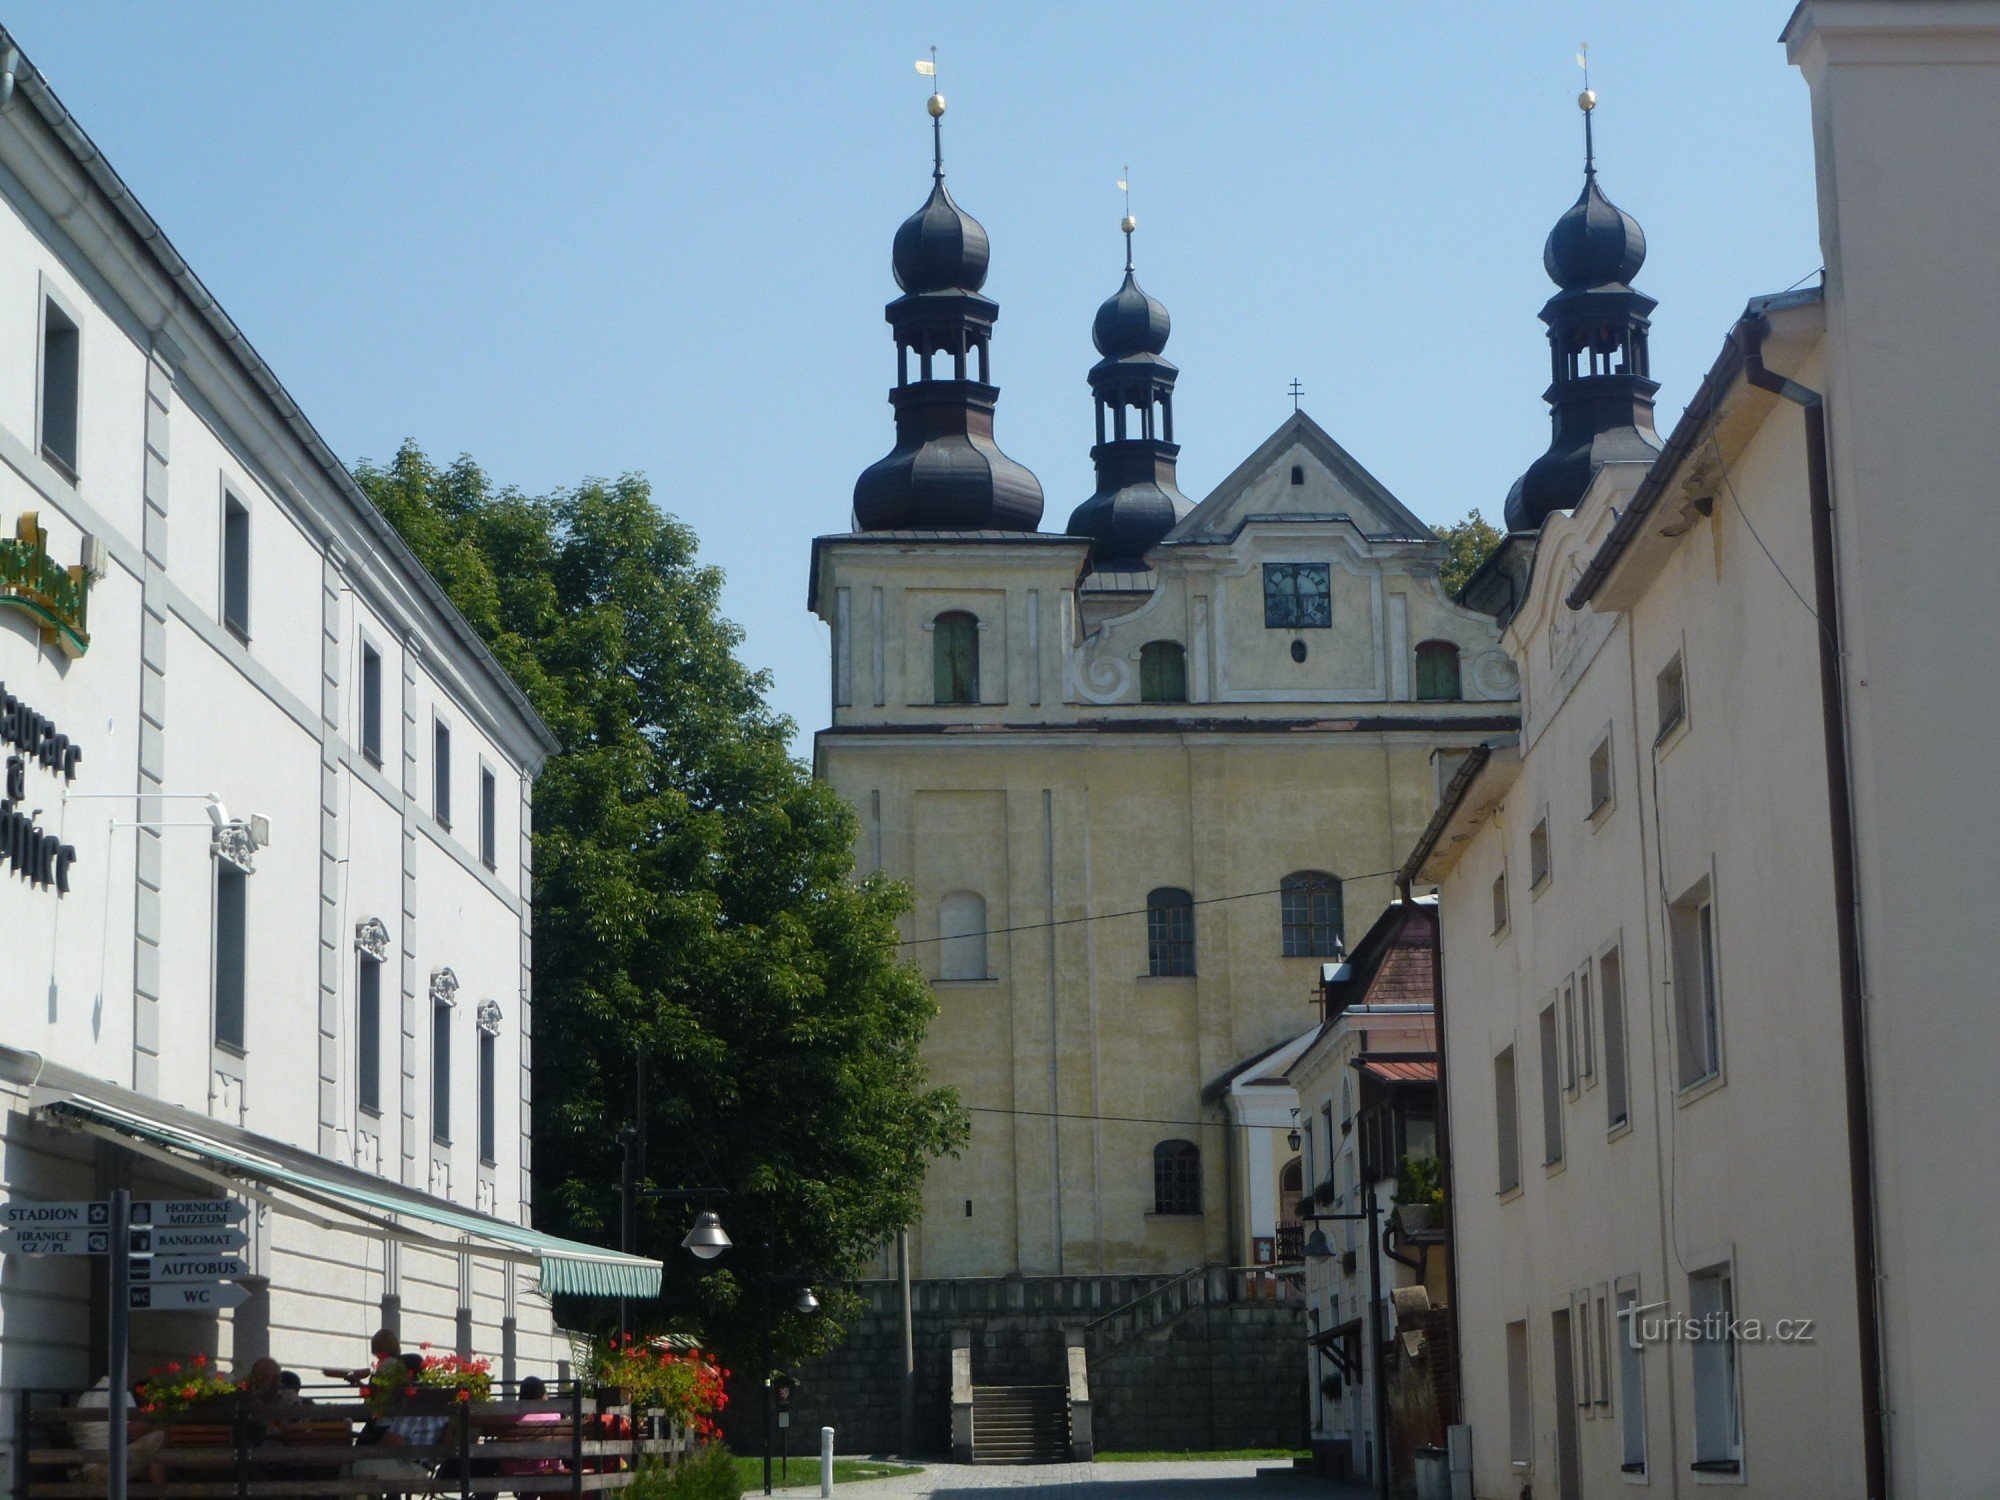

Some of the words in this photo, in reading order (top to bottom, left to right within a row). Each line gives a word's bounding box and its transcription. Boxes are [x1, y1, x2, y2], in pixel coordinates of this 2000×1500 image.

[165, 1201, 232, 1213] HORNICKÉ
[8, 1208, 78, 1221] STADION
[170, 1214, 227, 1224] MUZEUM
[17, 1231, 73, 1242] HRANICE
[159, 1235, 232, 1246] BANKOMAT
[22, 1243, 38, 1253] CZ
[52, 1243, 67, 1253] PL
[161, 1262, 238, 1276] AUTOBUS
[183, 1290, 211, 1303] WC
